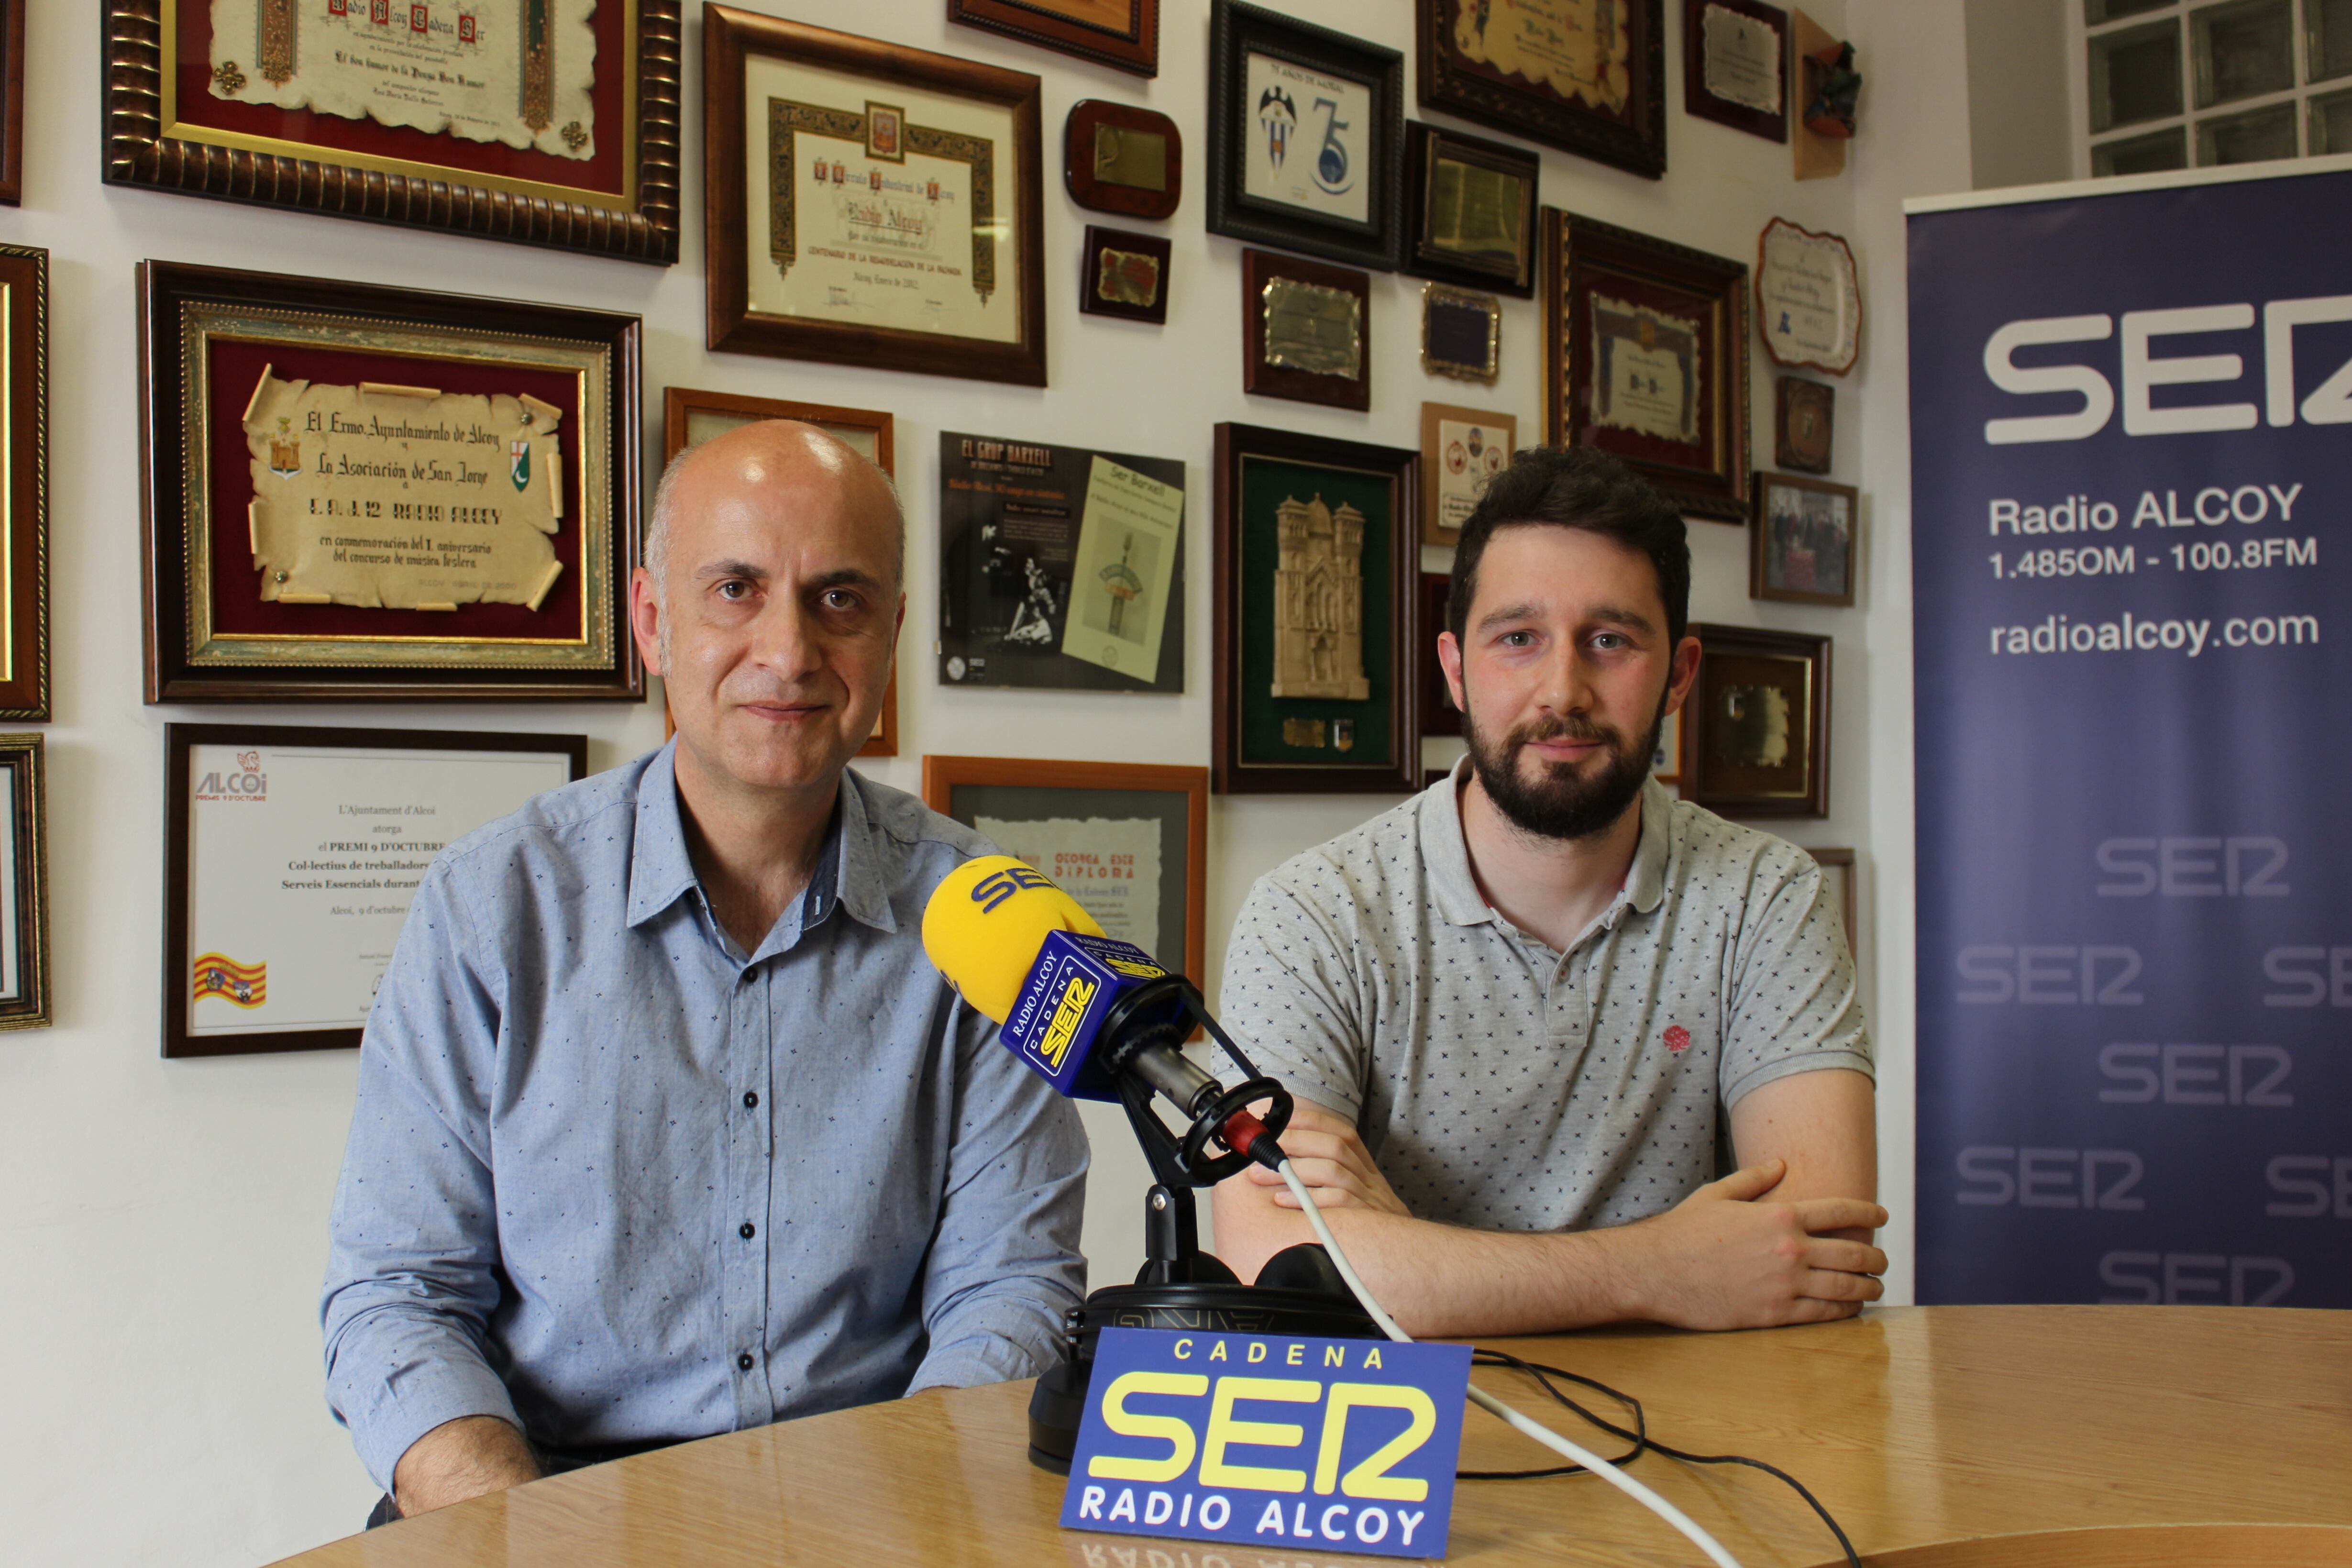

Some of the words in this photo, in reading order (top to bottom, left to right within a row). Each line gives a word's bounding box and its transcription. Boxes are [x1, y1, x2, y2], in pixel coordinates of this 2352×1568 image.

[411, 4, 453, 33] Cadena
[459, 15, 485, 43] Ser
[848, 200, 882, 224] Radio
[888, 208, 923, 232] Alcoy
[808, 246, 846, 259] CENTENARIO
[848, 252, 856, 261] DE
[859, 253, 867, 263] LA
[927, 264, 934, 272] LA
[304, 411, 321, 432] El
[366, 415, 450, 443] Ayuntamiento
[454, 423, 465, 442] de
[466, 423, 501, 453] Alcoy
[961, 439, 974, 458] EL
[977, 441, 1005, 460] GRUP
[1006, 444, 1052, 467] BARXELL
[316, 453, 333, 478] La
[337, 453, 407, 479] Asociación
[412, 459, 425, 480] de
[426, 460, 453, 483] San
[455, 461, 488, 491] Jorge
[1110, 465, 1129, 481] Ser
[1131, 473, 1166, 497] Barxell
[393, 502, 445, 522] RADIO
[451, 506, 502, 526] ALCOY
[1988, 495, 2118, 536] Radio
[2131, 483, 2303, 529] ALCOY
[320, 535, 332, 546] en
[410, 534, 423, 551] del
[437, 540, 492, 554] aniversario
[333, 548, 347, 562] del
[350, 553, 391, 564] concurso
[394, 550, 403, 565] de
[406, 552, 440, 567] música
[443, 552, 476, 568] festera
[2170, 537, 2318, 571] 100.8FM
[1990, 611, 2319, 657] radioalcoy.com
[339, 805, 403, 817] L'Ajuntament
[404, 805, 436, 816] d'Alcoi
[373, 824, 402, 835] atorga
[318, 842, 328, 852] el
[329, 842, 368, 852] PREMI
[371, 844, 378, 853] 9
[380, 842, 445, 852] D'OCTUBRE
[349, 861, 363, 871] de
[365, 860, 429, 871] treballadors
[1054, 866, 1134, 879] DIPLOMA
[2096, 836, 2290, 898] SER
[281, 880, 322, 889] Serveis
[325, 879, 381, 889] Essencials
[384, 878, 420, 889] durant
[330, 906, 354, 916] Alcoi,
[359, 907, 364, 916] 9
[366, 905, 406, 915] d'octubre
[1075, 937, 1108, 949] RADIO
[1108, 943, 1139, 954] ALCOY
[1093, 951, 1157, 966] CADENA
[1956, 945, 2144, 1005] SER
[1012, 996, 1039, 1038] RADIO
[1031, 950, 1058, 998] ALCOY
[1030, 966, 1074, 1049] CADENA
[1040, 977, 1094, 1068] SER
[2098, 1043, 2294, 1107] SER
[1956, 1146, 2146, 1211] SER
[2099, 1251, 2295, 1307] SER
[1173, 1338, 1383, 1370] CADENA
[1087, 1370, 1437, 1502] SER
[1079, 1485, 1232, 1531] RADIO
[1256, 1499, 1425, 1546] ALCOY
